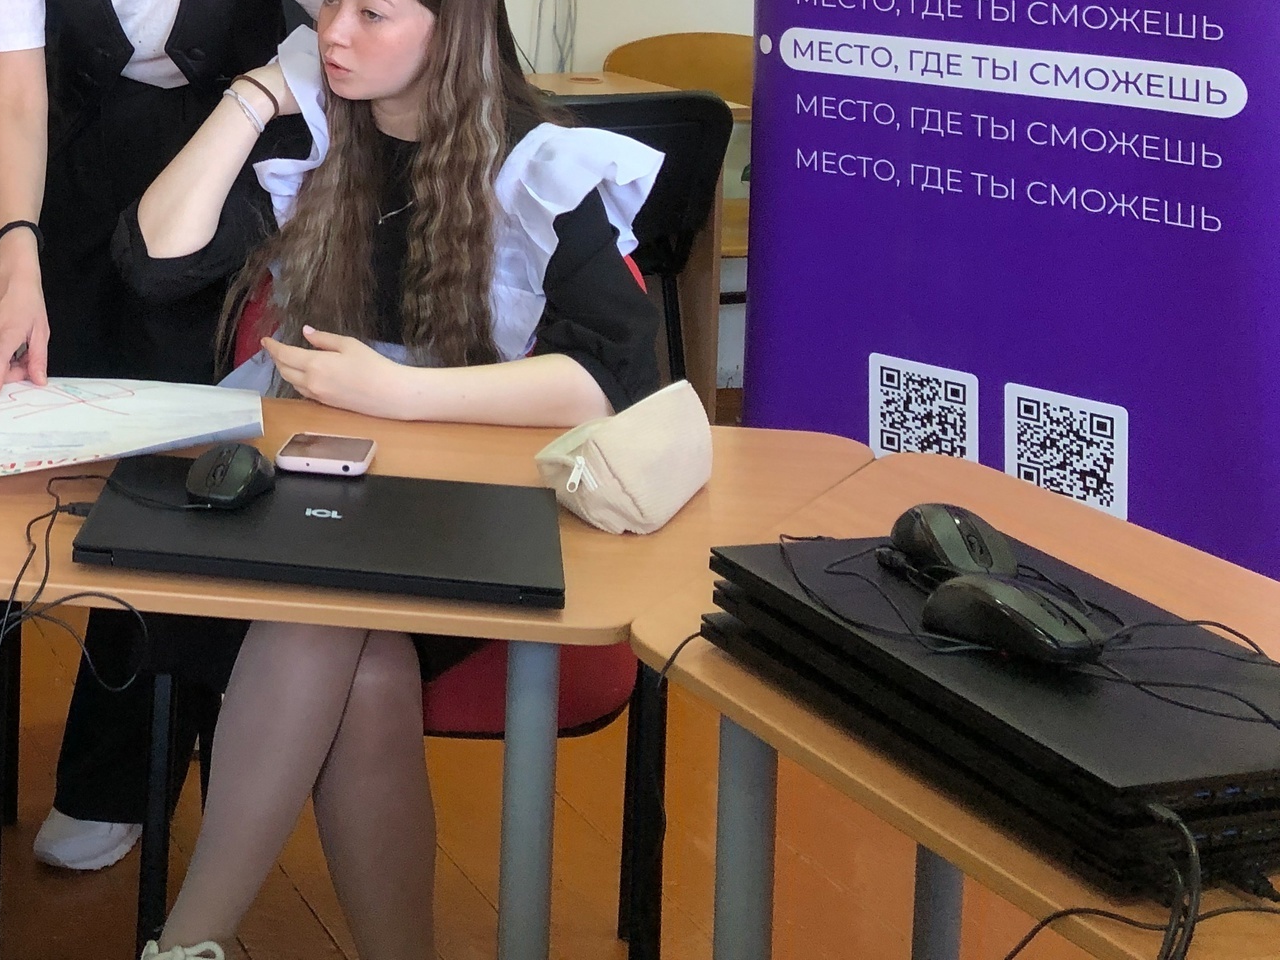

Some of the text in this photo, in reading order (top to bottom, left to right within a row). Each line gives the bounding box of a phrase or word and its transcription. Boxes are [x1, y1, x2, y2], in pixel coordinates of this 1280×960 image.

[1028, 1, 1226, 41] СМОЖЕШЬ
[793, 38, 1228, 105] МЕСТО, ГДЕ ТЫ СМОЖЕШЬ
[797, 93, 1223, 170] МЕСТО, ГДЕ ТЫ СМОЖЕШЬ
[797, 147, 1223, 233] МЕСТО, ГДЕ ТЫ СМОЖЕШЬ
[305, 508, 342, 518] ICL
